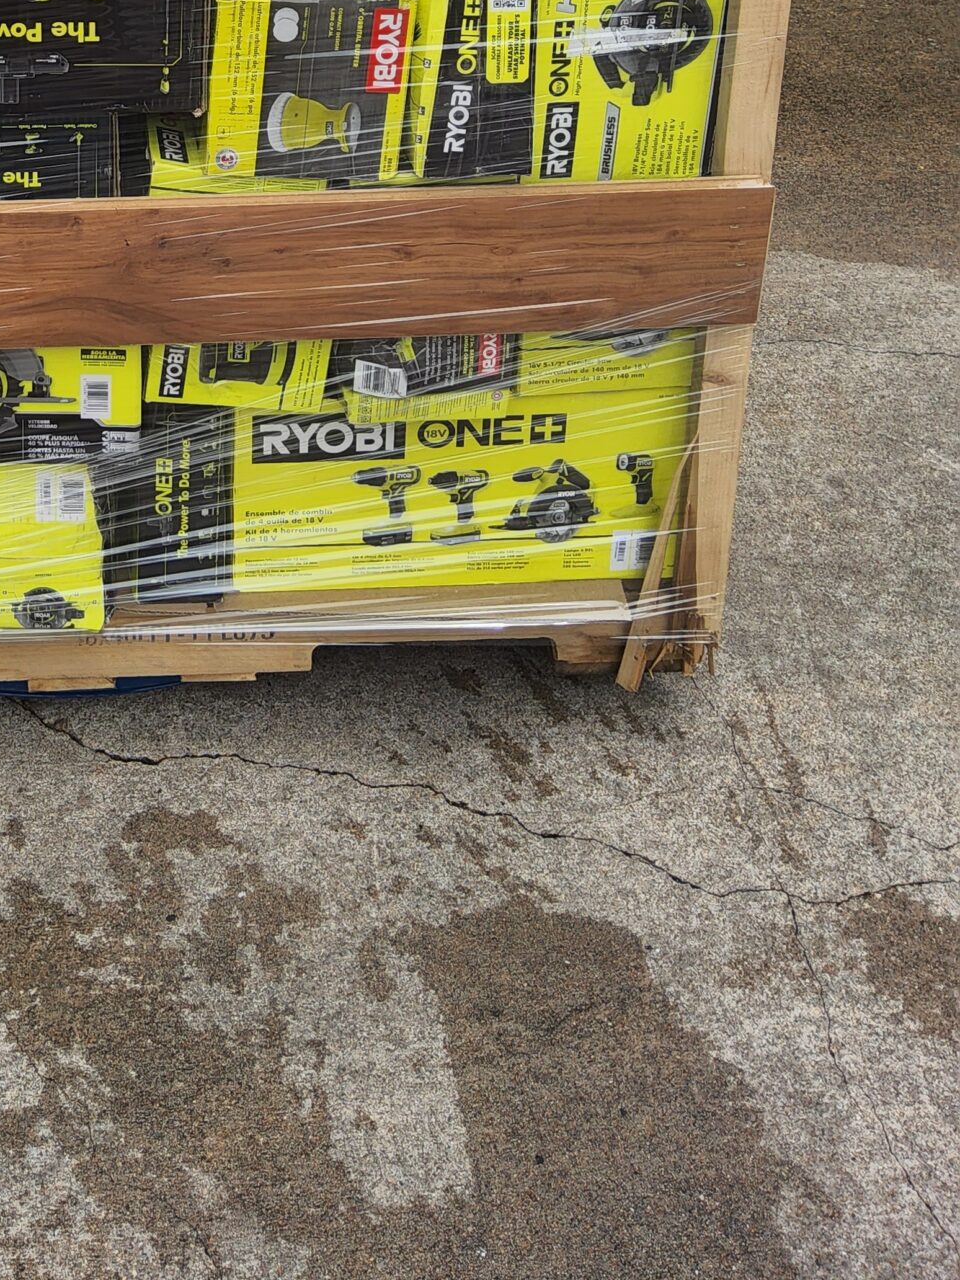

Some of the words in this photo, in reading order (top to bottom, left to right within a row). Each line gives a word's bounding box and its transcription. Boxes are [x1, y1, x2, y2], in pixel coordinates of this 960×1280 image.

[51, 22, 101, 43] The
[355, 16, 364, 43] ORBITAL
[372, 12, 403, 87] RYOBI
[506, 42, 514, 73] UNLEASH
[443, 84, 474, 153] RYOBI
[160, 129, 185, 161] RYOBI
[545, 106, 574, 176] RYOBI
[601, 116, 617, 175] BRUSHLESS
[2, 172, 42, 188] The
[163, 345, 185, 396] RYOBI
[552, 377, 579, 385] circular
[259, 421, 396, 456] RYOBI
[417, 413, 568, 449] ONE+
[425, 429, 446, 439] 18V
[178, 437, 191, 471] More.
[178, 473, 190, 487] Do
[178, 488, 190, 503] To
[178, 504, 190, 538] Power
[245, 509, 286, 517] Ensemble
